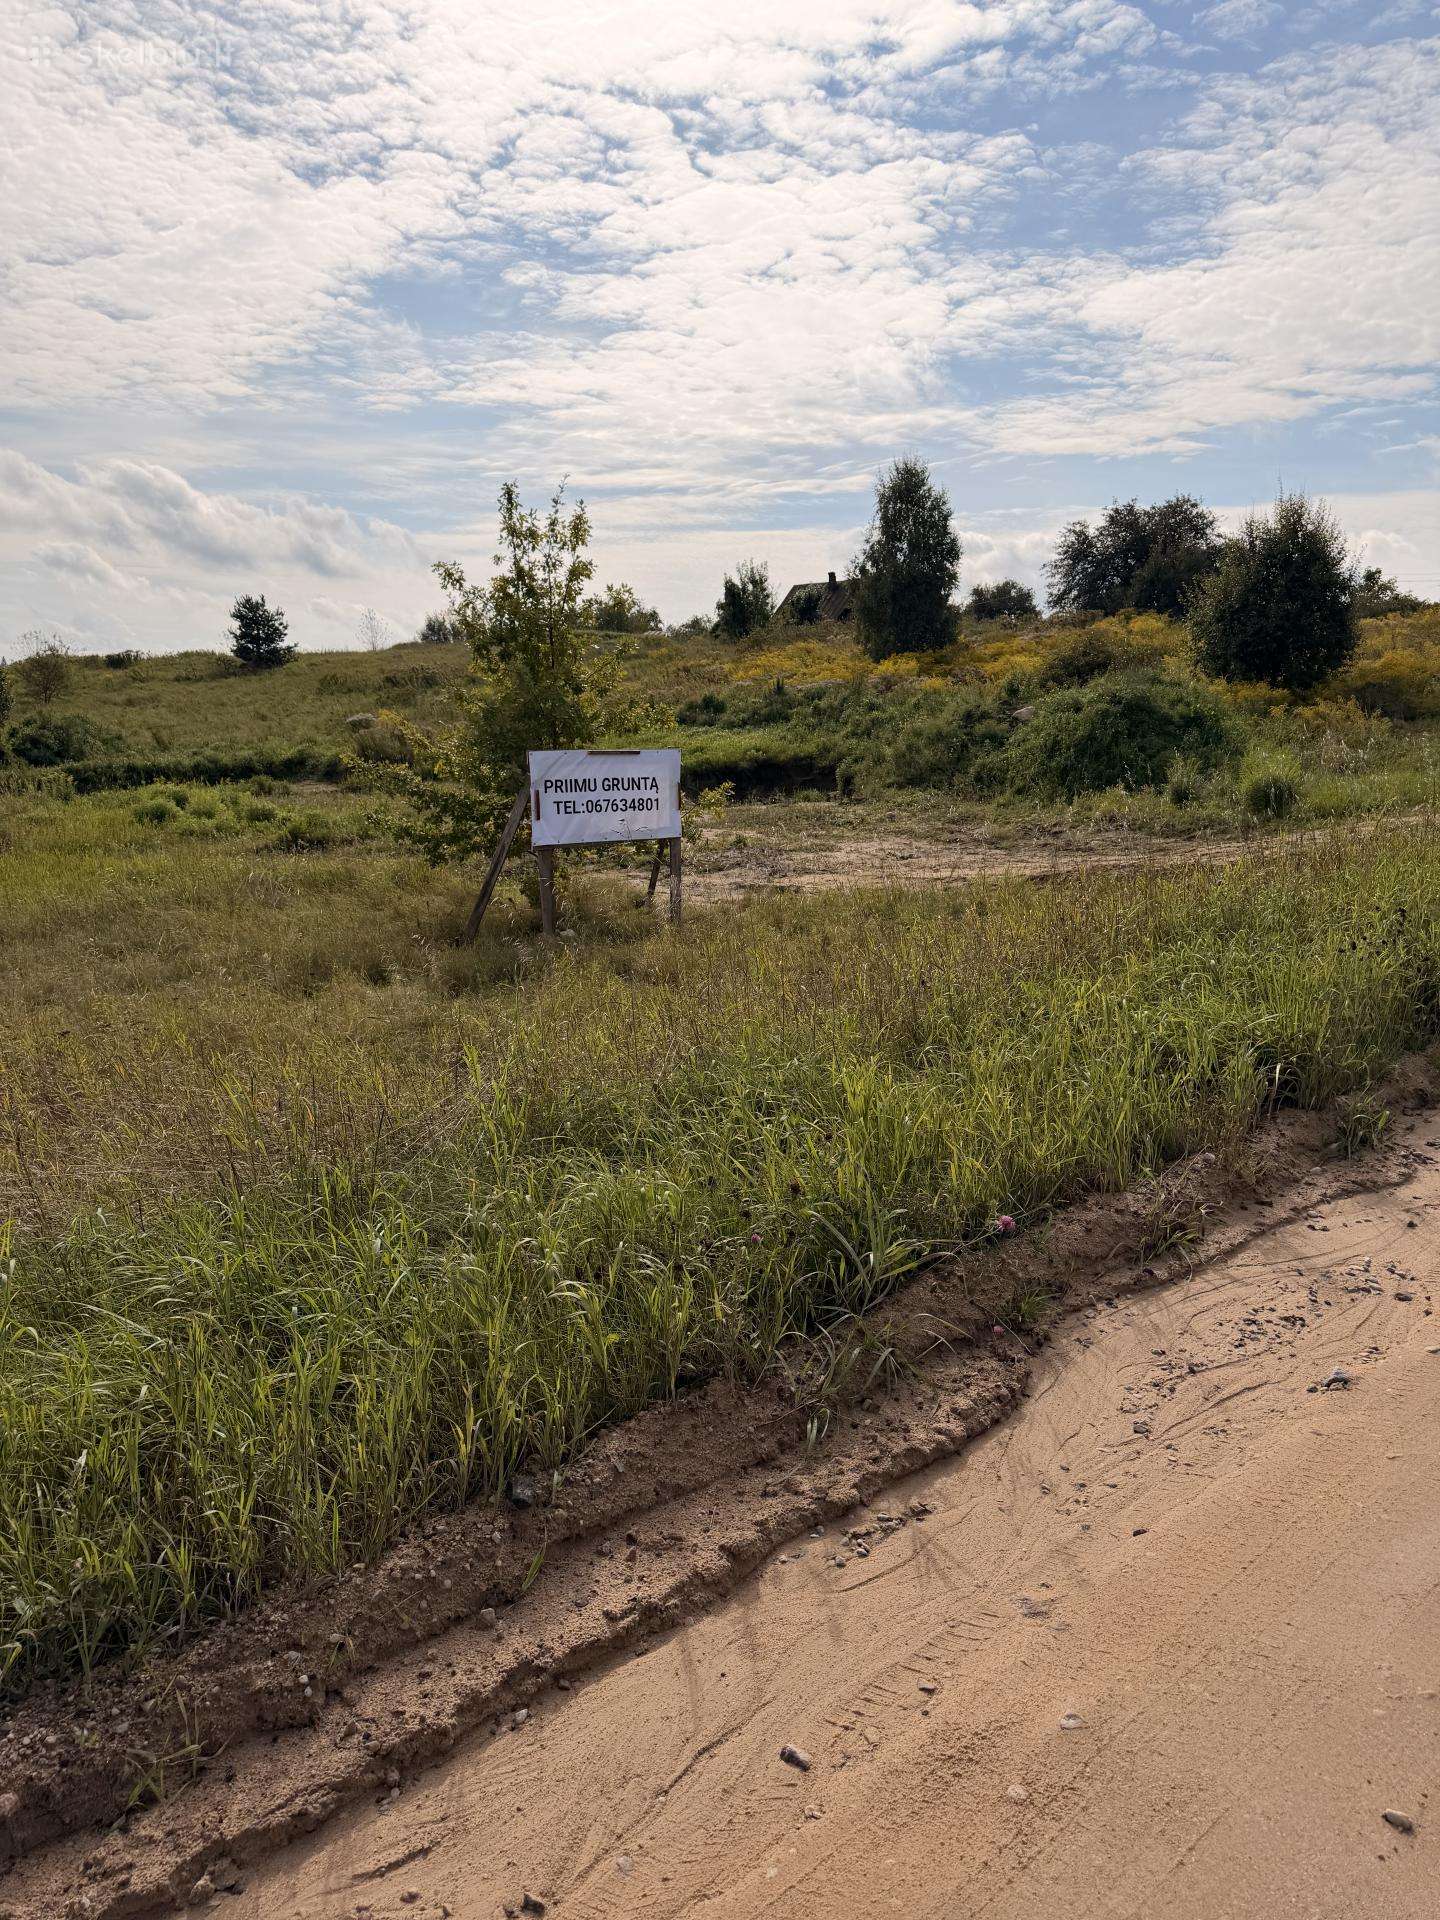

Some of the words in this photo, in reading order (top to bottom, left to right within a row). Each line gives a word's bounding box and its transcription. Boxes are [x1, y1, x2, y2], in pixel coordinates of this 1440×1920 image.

[544, 778, 598, 793] PRIIMU
[602, 776, 659, 794] GRUNTĄ
[553, 798, 660, 815] TEL:067634801
